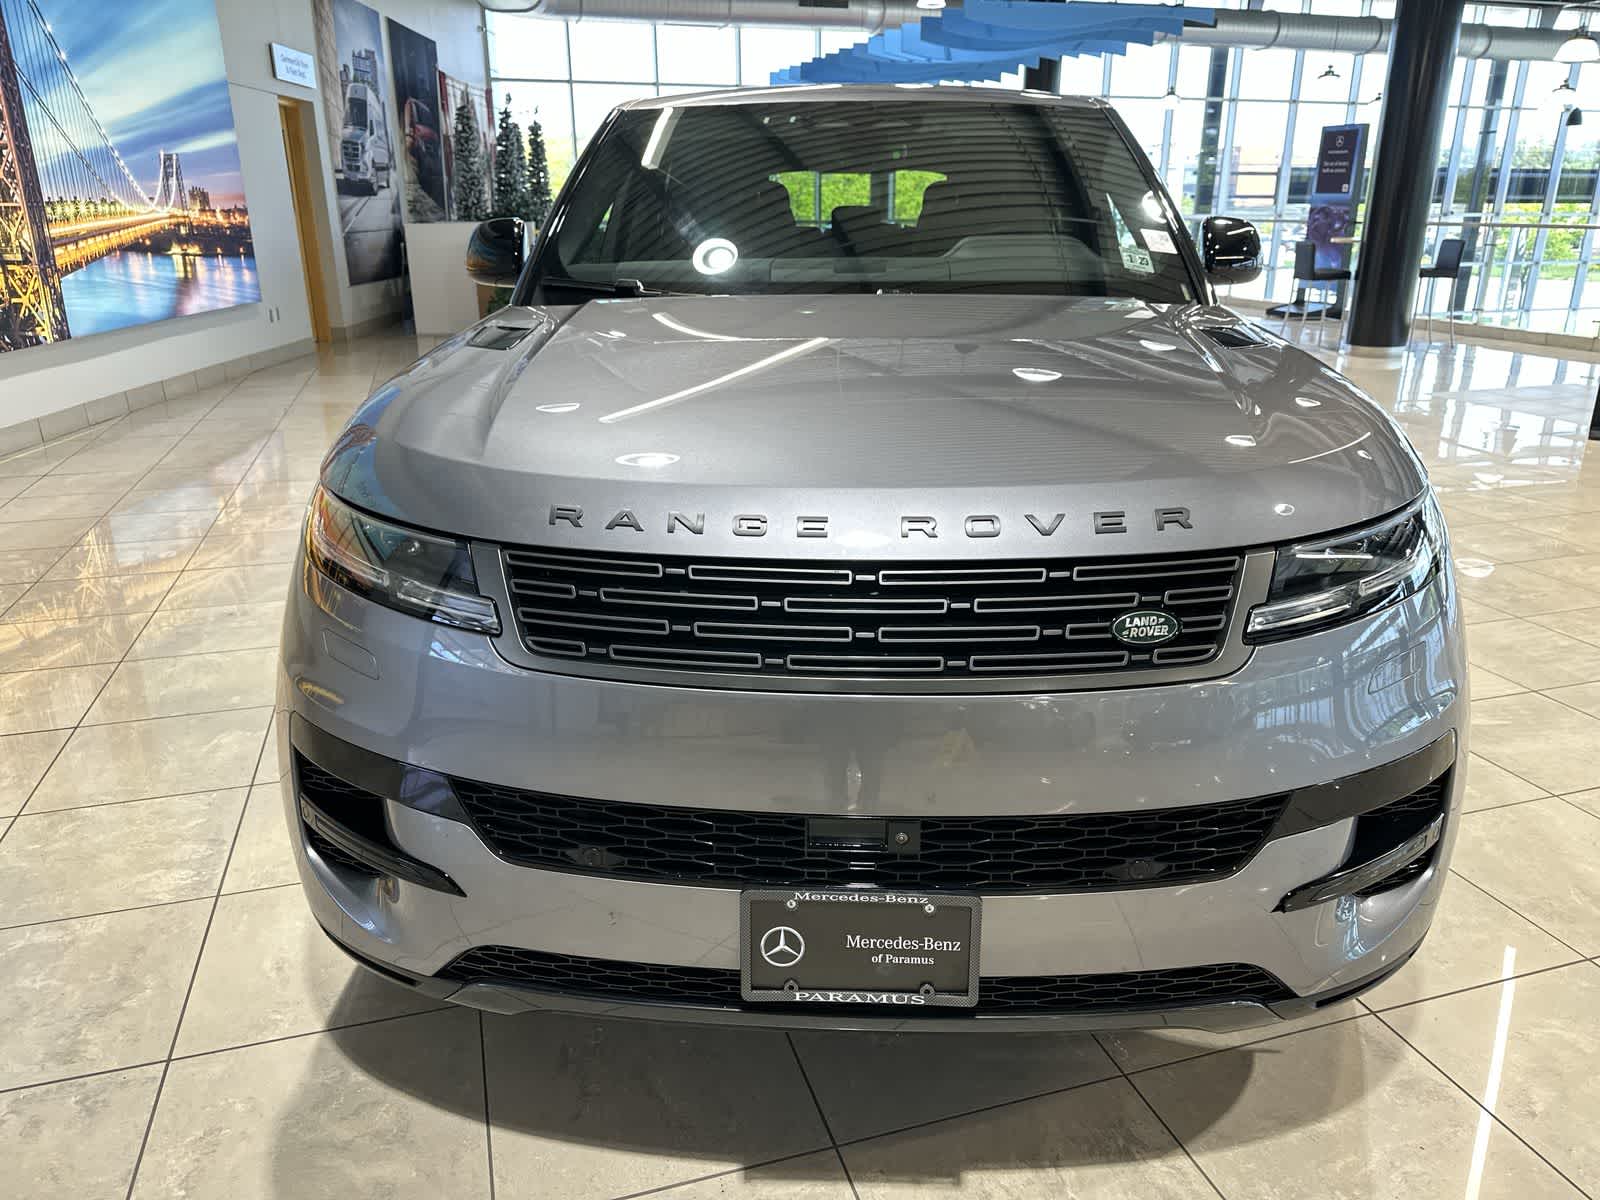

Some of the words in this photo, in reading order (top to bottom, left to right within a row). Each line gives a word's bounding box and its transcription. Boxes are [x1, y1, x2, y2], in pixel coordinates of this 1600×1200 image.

[549, 503, 829, 538] RANGE
[900, 507, 1193, 538] ROVER
[1125, 616, 1157, 627] LAND
[1129, 625, 1168, 637] ROVER
[793, 892, 929, 904] Mercedes-Benz
[846, 935, 961, 951] Mercedes-Benz
[871, 954, 883, 964] of
[885, 954, 935, 965] Paramus
[794, 992, 926, 1005] PARAMUS
